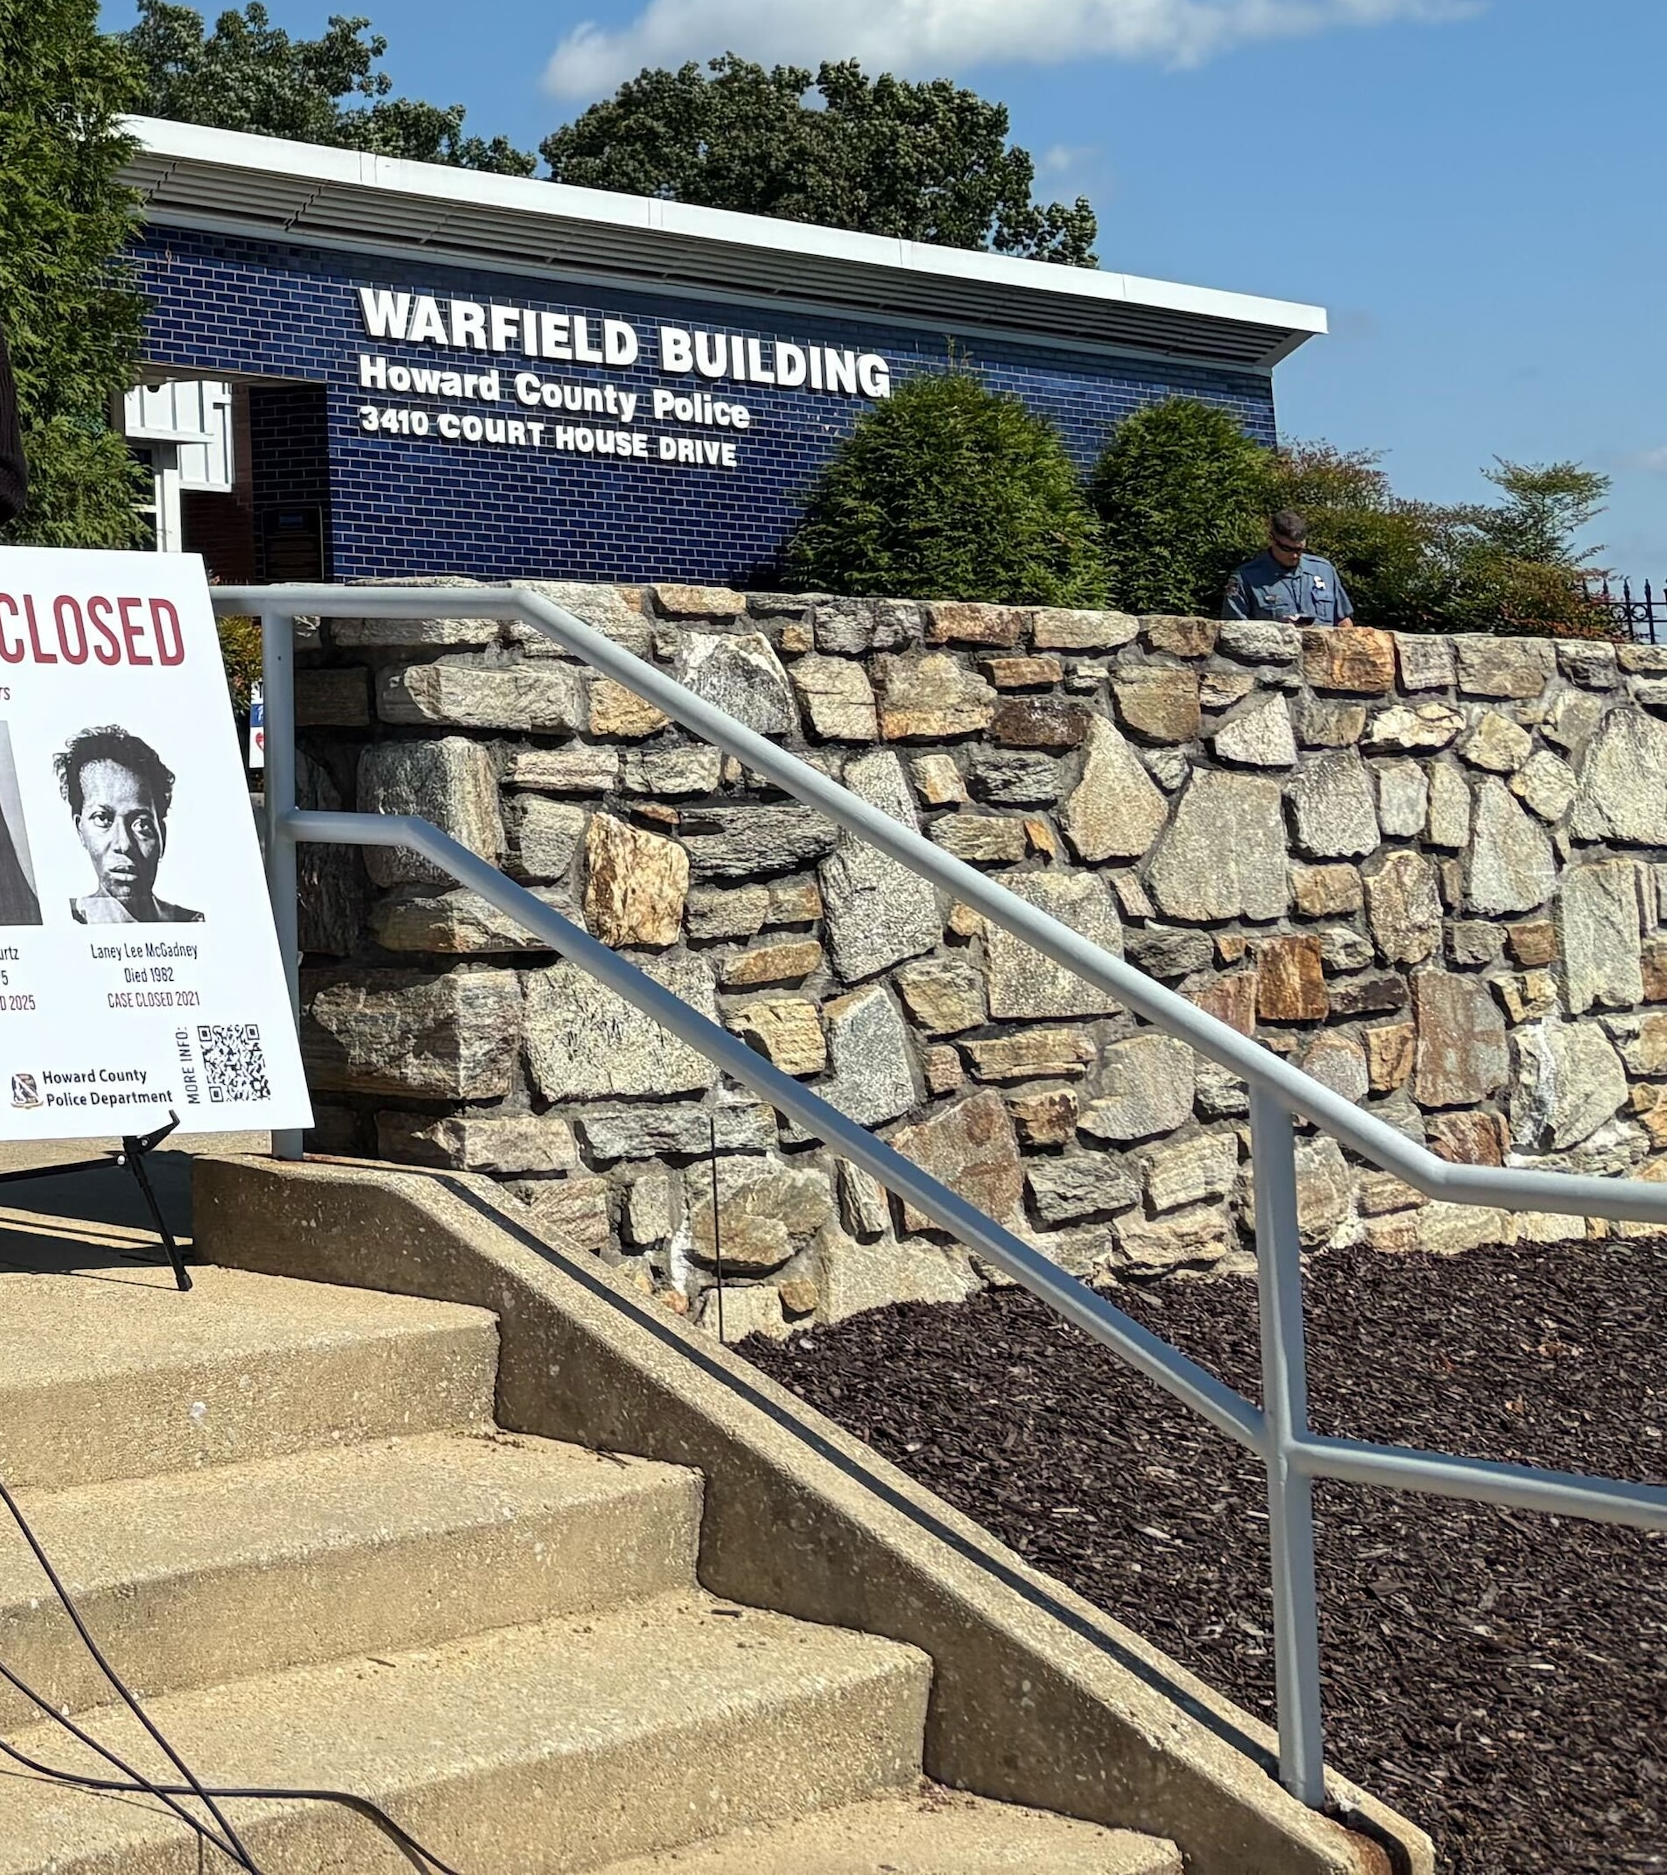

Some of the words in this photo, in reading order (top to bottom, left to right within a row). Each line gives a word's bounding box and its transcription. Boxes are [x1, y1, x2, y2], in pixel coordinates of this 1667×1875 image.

[357, 286, 639, 366] WARFIELD
[658, 325, 891, 399] BUILDING
[359, 353, 501, 402] Howard
[514, 372, 638, 423] County
[652, 388, 751, 429] Police
[358, 405, 430, 436] 3410
[436, 412, 545, 446] COURT
[555, 425, 649, 458] HOUSE
[658, 435, 738, 468] DRIVE
[90, 943, 122, 961] Laney
[123, 942, 143, 958] Lee
[123, 967, 148, 983] Died
[150, 966, 175, 982] 1982
[9, 994, 36, 1011] 2025
[107, 992, 134, 1008] CASE
[135, 992, 174, 1007] CLOSED
[175, 991, 200, 1006] 2021
[175, 1026, 193, 1062] INFO:
[42, 1070, 95, 1085] Howard
[99, 1069, 147, 1084] County
[183, 1067, 201, 1105] MORE
[46, 1091, 88, 1108] Police
[91, 1090, 173, 1108] Department
